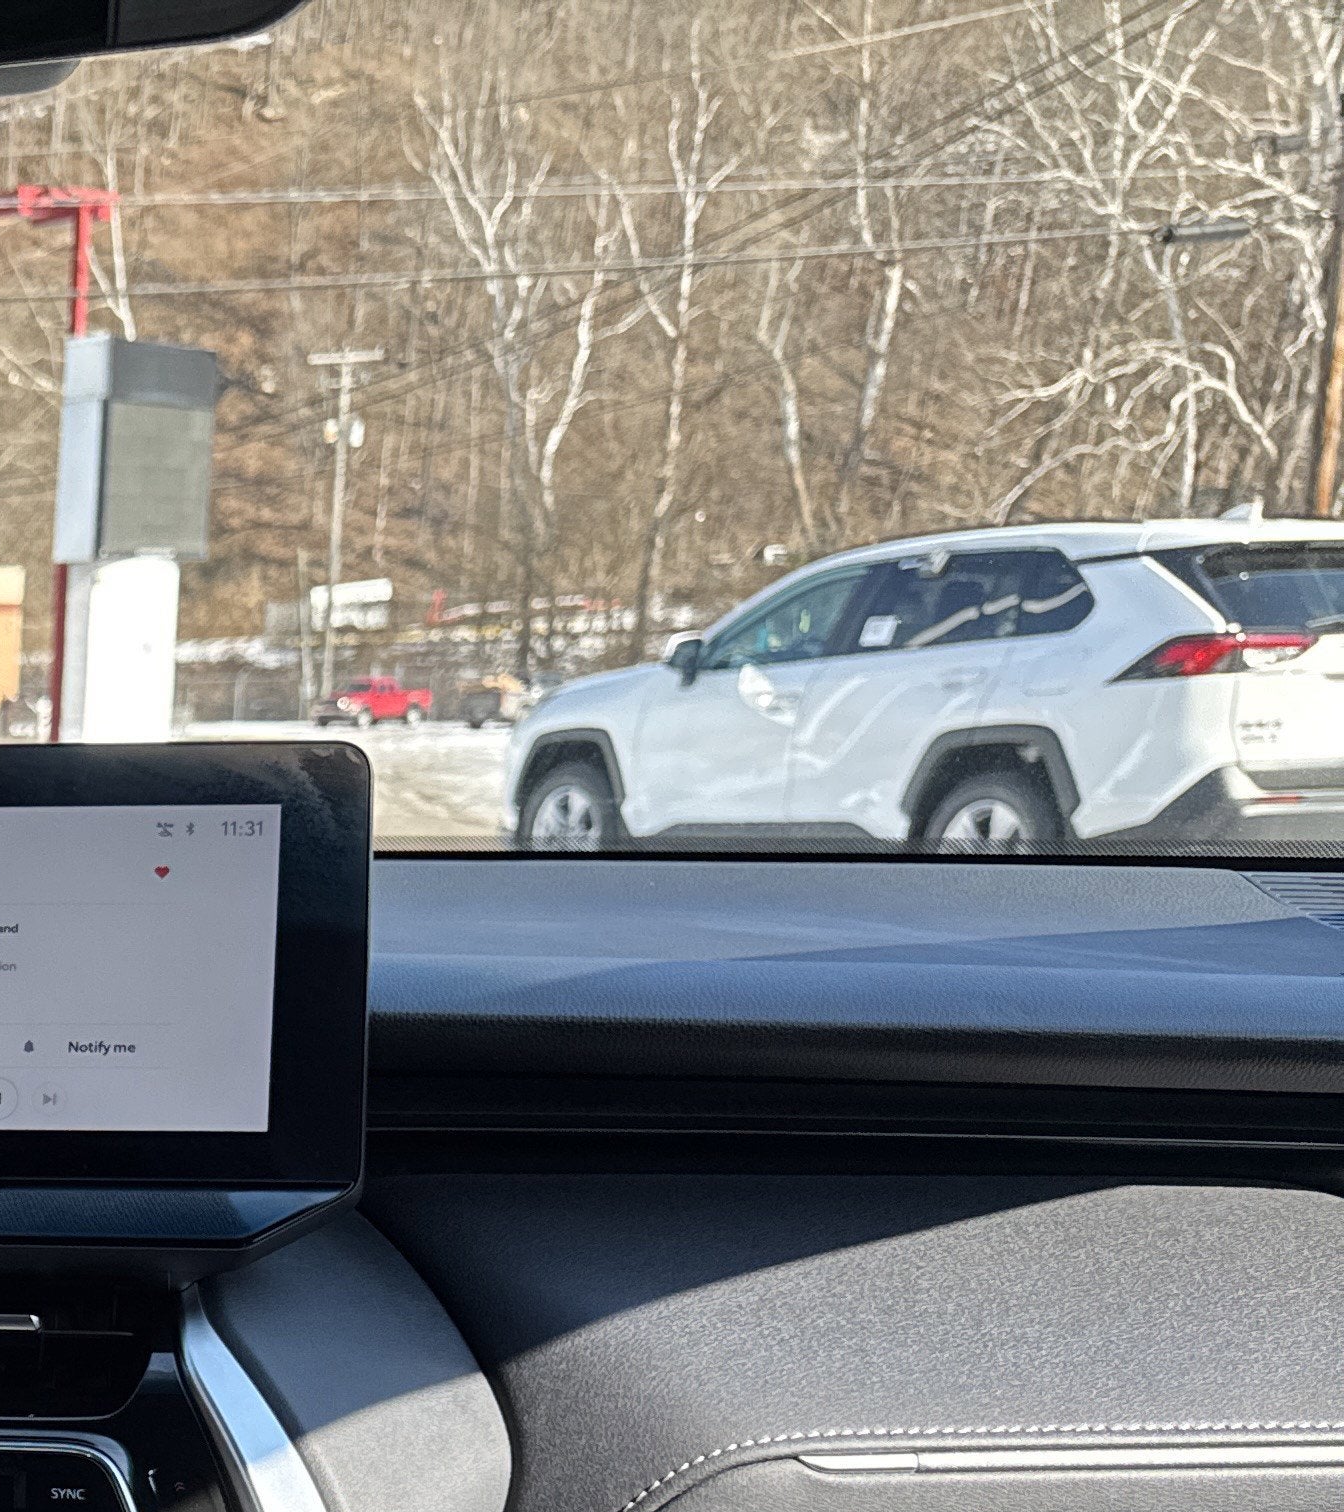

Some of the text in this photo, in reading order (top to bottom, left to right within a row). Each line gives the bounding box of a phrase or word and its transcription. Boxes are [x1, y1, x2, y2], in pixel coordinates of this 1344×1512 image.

[221, 820, 264, 837] 11:31
[67, 1040, 137, 1056] Notify me
[50, 1487, 86, 1501] SYNC
